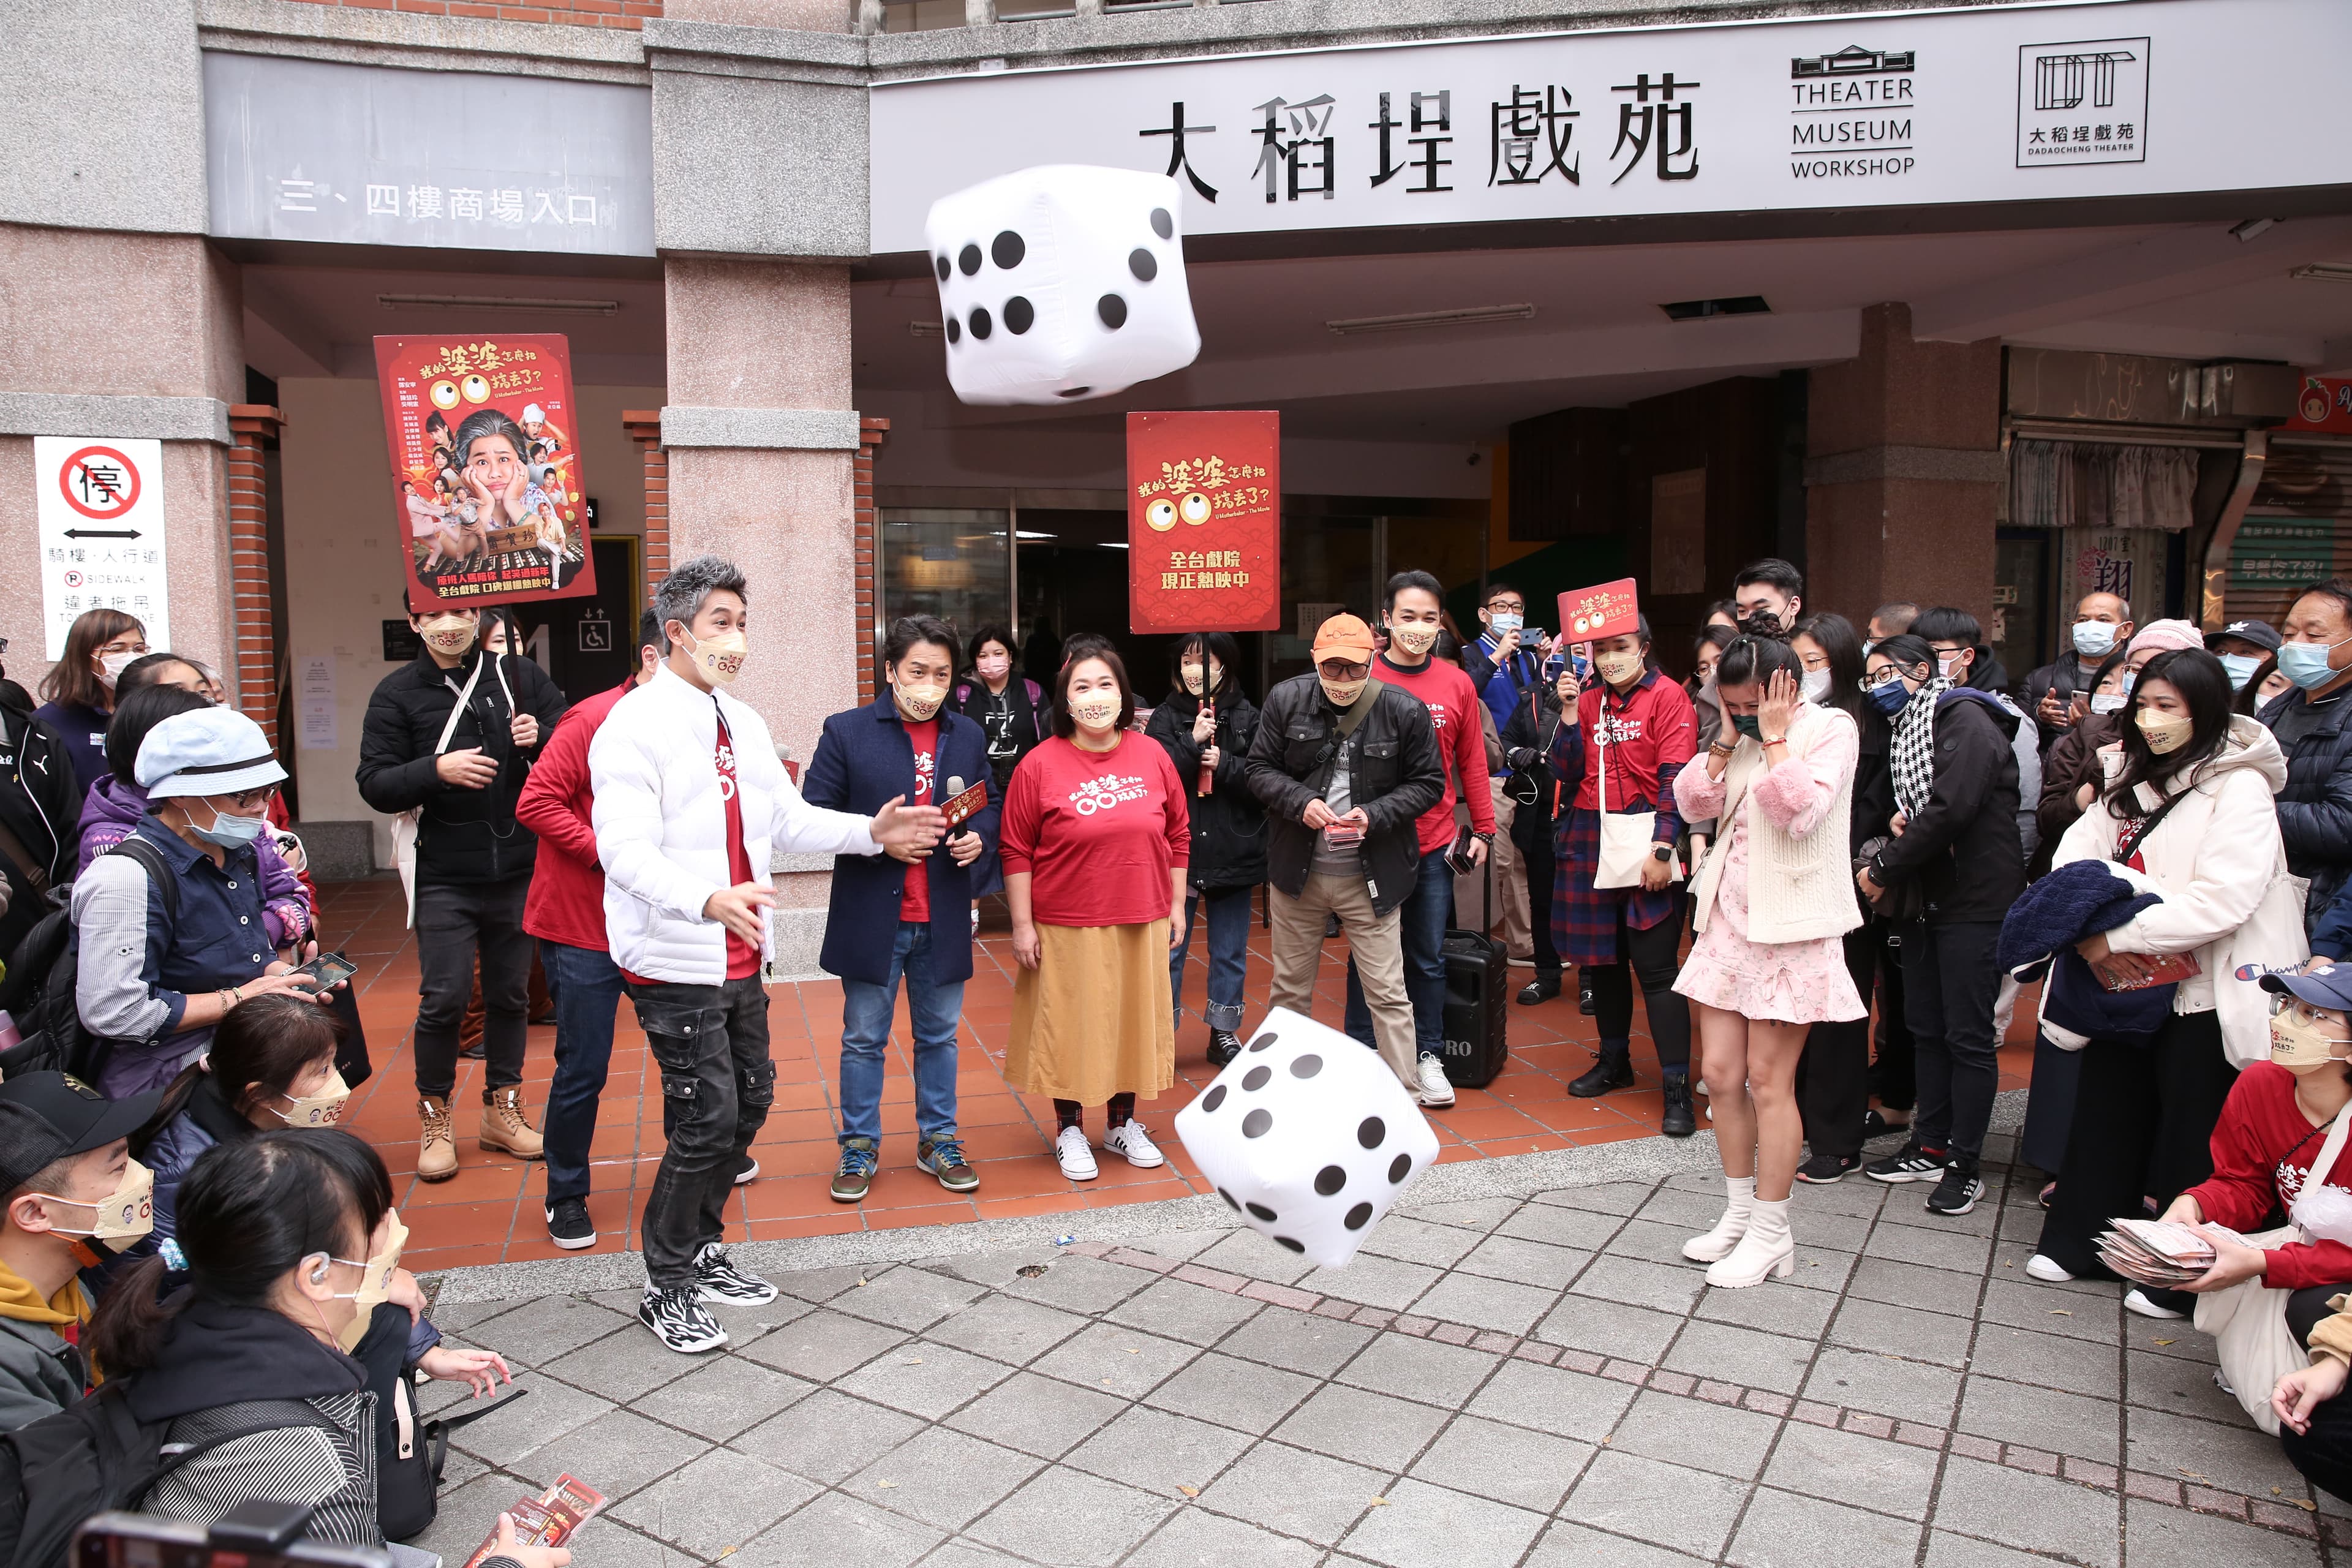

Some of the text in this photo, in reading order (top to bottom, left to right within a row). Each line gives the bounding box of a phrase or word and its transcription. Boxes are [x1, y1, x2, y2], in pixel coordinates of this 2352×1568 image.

[1792, 78, 1913, 105] THEATER
[1139, 72, 1701, 203] 大稻埕戲苑
[1793, 119, 1912, 145] MUSEUM
[2029, 123, 2135, 144] 大稻埕戲苑
[2028, 143, 2135, 156] DADAOCHENG THEATER
[1791, 157, 1915, 178] WORKSHOP
[280, 178, 598, 227] 三、四樓商場入口
[80, 465, 121, 503] 停
[1137, 455, 1266, 497] 我的婆婆怎麼把
[1170, 550, 1240, 570] 全台戲院
[87, 575, 146, 584] SIDEWALK
[1161, 570, 1250, 590] 現正熱映中
[439, 584, 481, 598] 全台戲院
[64, 595, 149, 610] 違者拖吊
